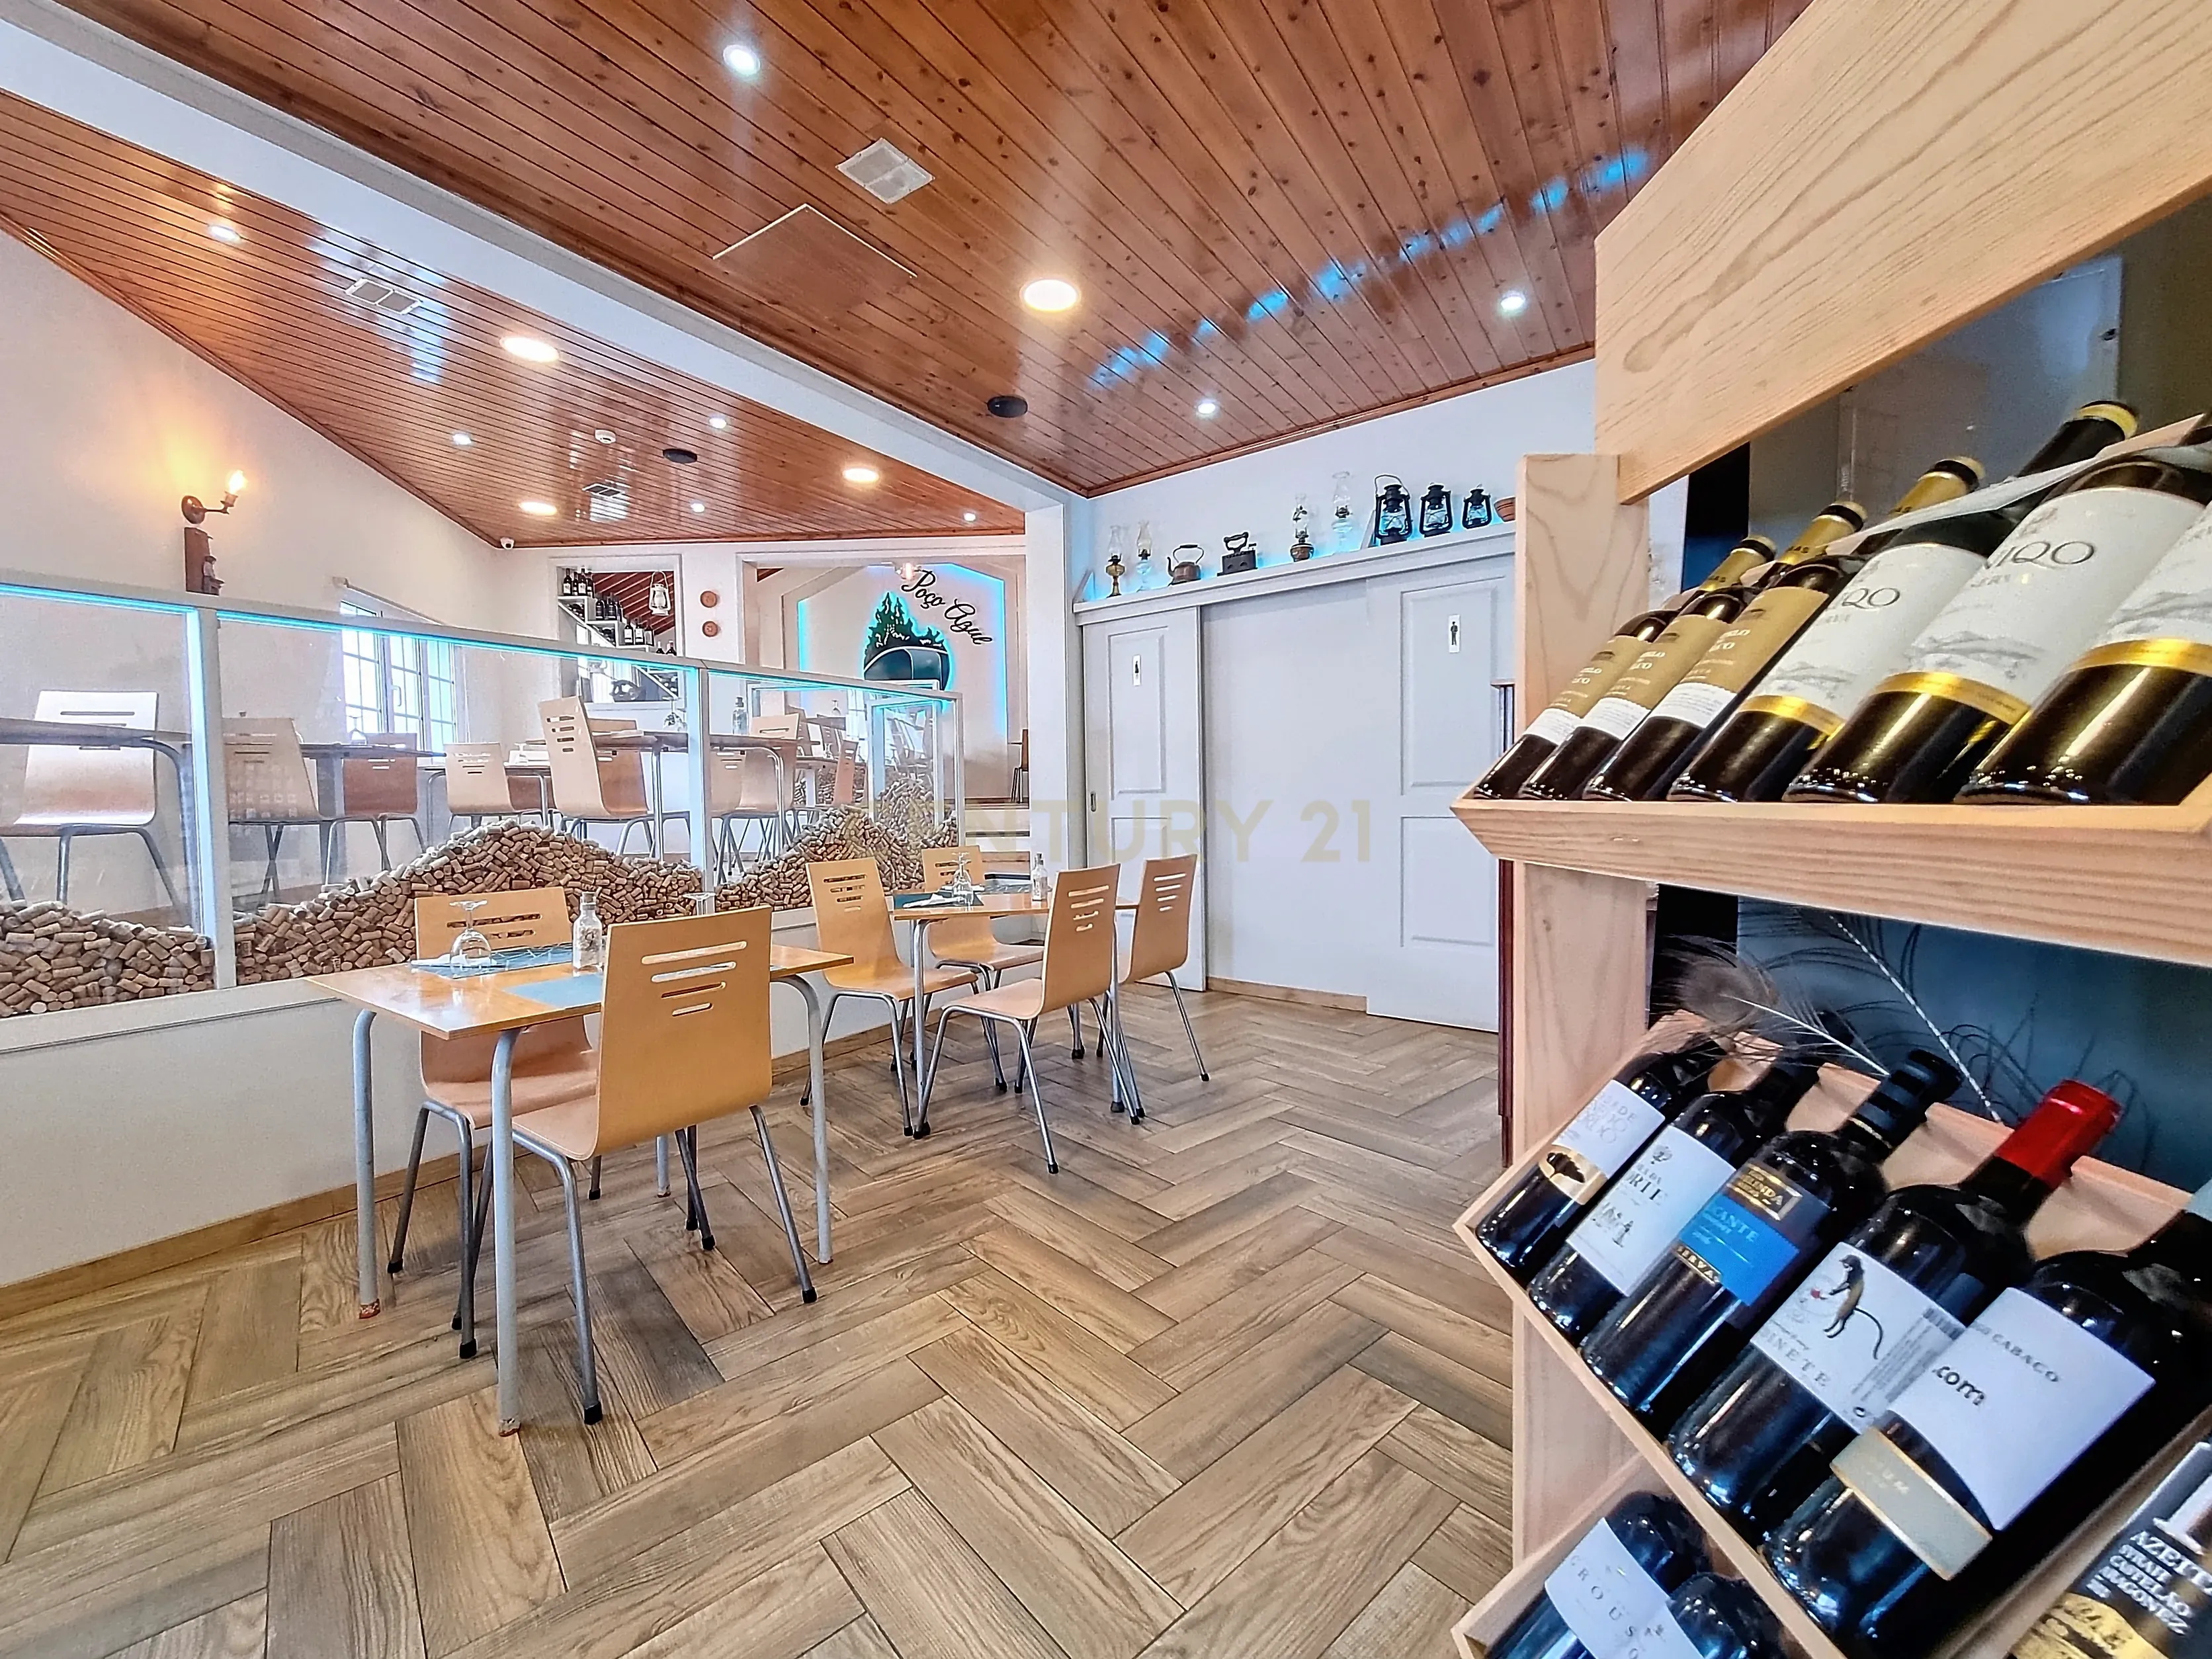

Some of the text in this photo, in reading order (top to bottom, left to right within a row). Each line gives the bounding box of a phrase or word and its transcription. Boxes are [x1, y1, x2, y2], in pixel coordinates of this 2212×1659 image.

[901, 569, 993, 645] Poço Azul
[2130, 1530, 2212, 1596] AZEIT
